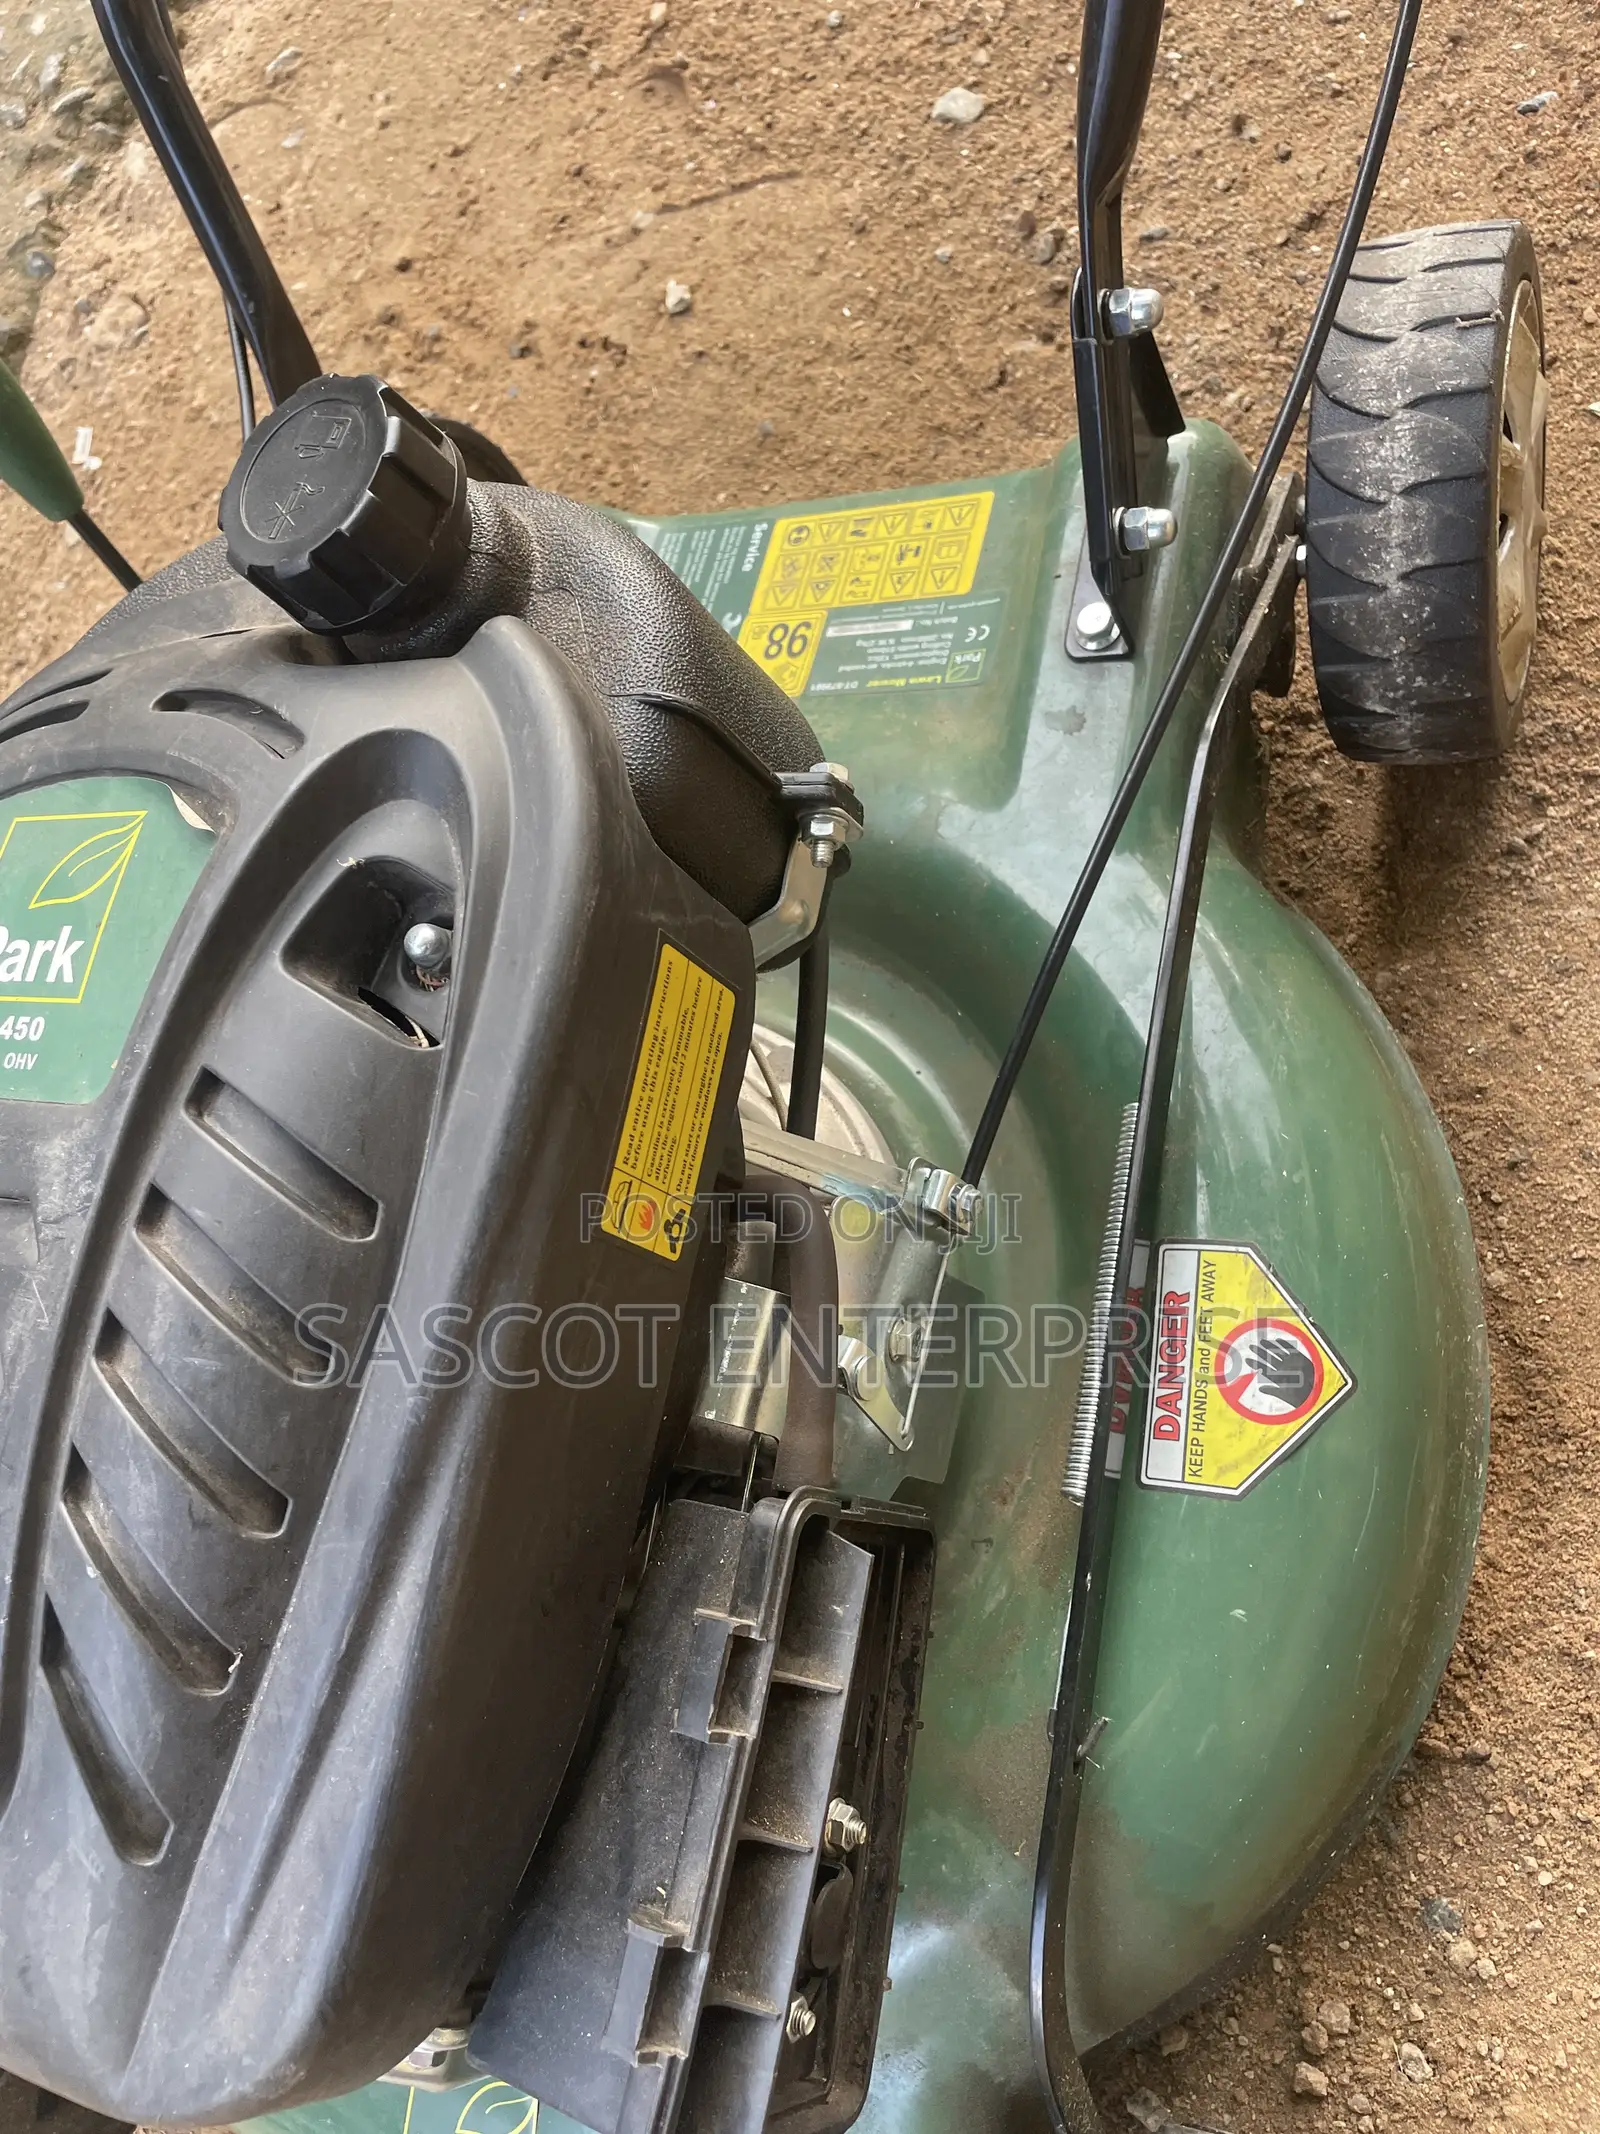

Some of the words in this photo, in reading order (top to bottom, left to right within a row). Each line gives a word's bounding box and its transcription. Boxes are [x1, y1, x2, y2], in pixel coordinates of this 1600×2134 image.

[741, 522, 768, 572] Service
[764, 621, 811, 660] 98
[955, 652, 981, 664] Park
[692, 977, 703, 1009] before
[0, 1015, 46, 1041] 450
[684, 1011, 696, 1052] minutes
[3, 1052, 38, 1070] OHV
[623, 1134, 635, 1165] Read
[632, 1095, 644, 1131] entire
[641, 1034, 658, 1092] operating
[654, 960, 673, 1031] instructions
[675, 1062, 685, 1083] cool
[631, 1131, 644, 1170] before
[641, 1096, 654, 1127] using
[649, 1071, 660, 1092] this
[655, 1026, 668, 1068] engine.
[672, 1085, 679, 1095] to
[676, 1178, 683, 1192] Do
[680, 1159, 688, 1176] not
[684, 1133, 693, 1157] start
[689, 1120, 696, 1132] or
[697, 1067, 708, 1099] engine
[704, 1056, 710, 1065] in
[708, 1012, 719, 1053] enclosed
[715, 989, 724, 1011] area.
[646, 1131, 662, 1177] Gasoline
[658, 1121, 664, 1129] is
[661, 1067, 676, 1118] extremely
[665, 1097, 677, 1132] engine
[683, 1172, 692, 1196] even
[690, 1134, 701, 1162] doors
[697, 1121, 703, 1132] or
[701, 1077, 713, 1118] windows
[710, 1059, 718, 1074] are
[714, 1032, 723, 1057] open.
[660, 1134, 668, 1150] the
[654, 1153, 665, 1181] allow
[1200, 1259, 1217, 1304] AWAY
[1198, 1306, 1214, 1344] FEET
[1153, 1290, 1191, 1442] DANGER
[1200, 1346, 1211, 1376] and
[1191, 1379, 1208, 1435] HANDS
[1188, 1437, 1205, 1478] KEEP
